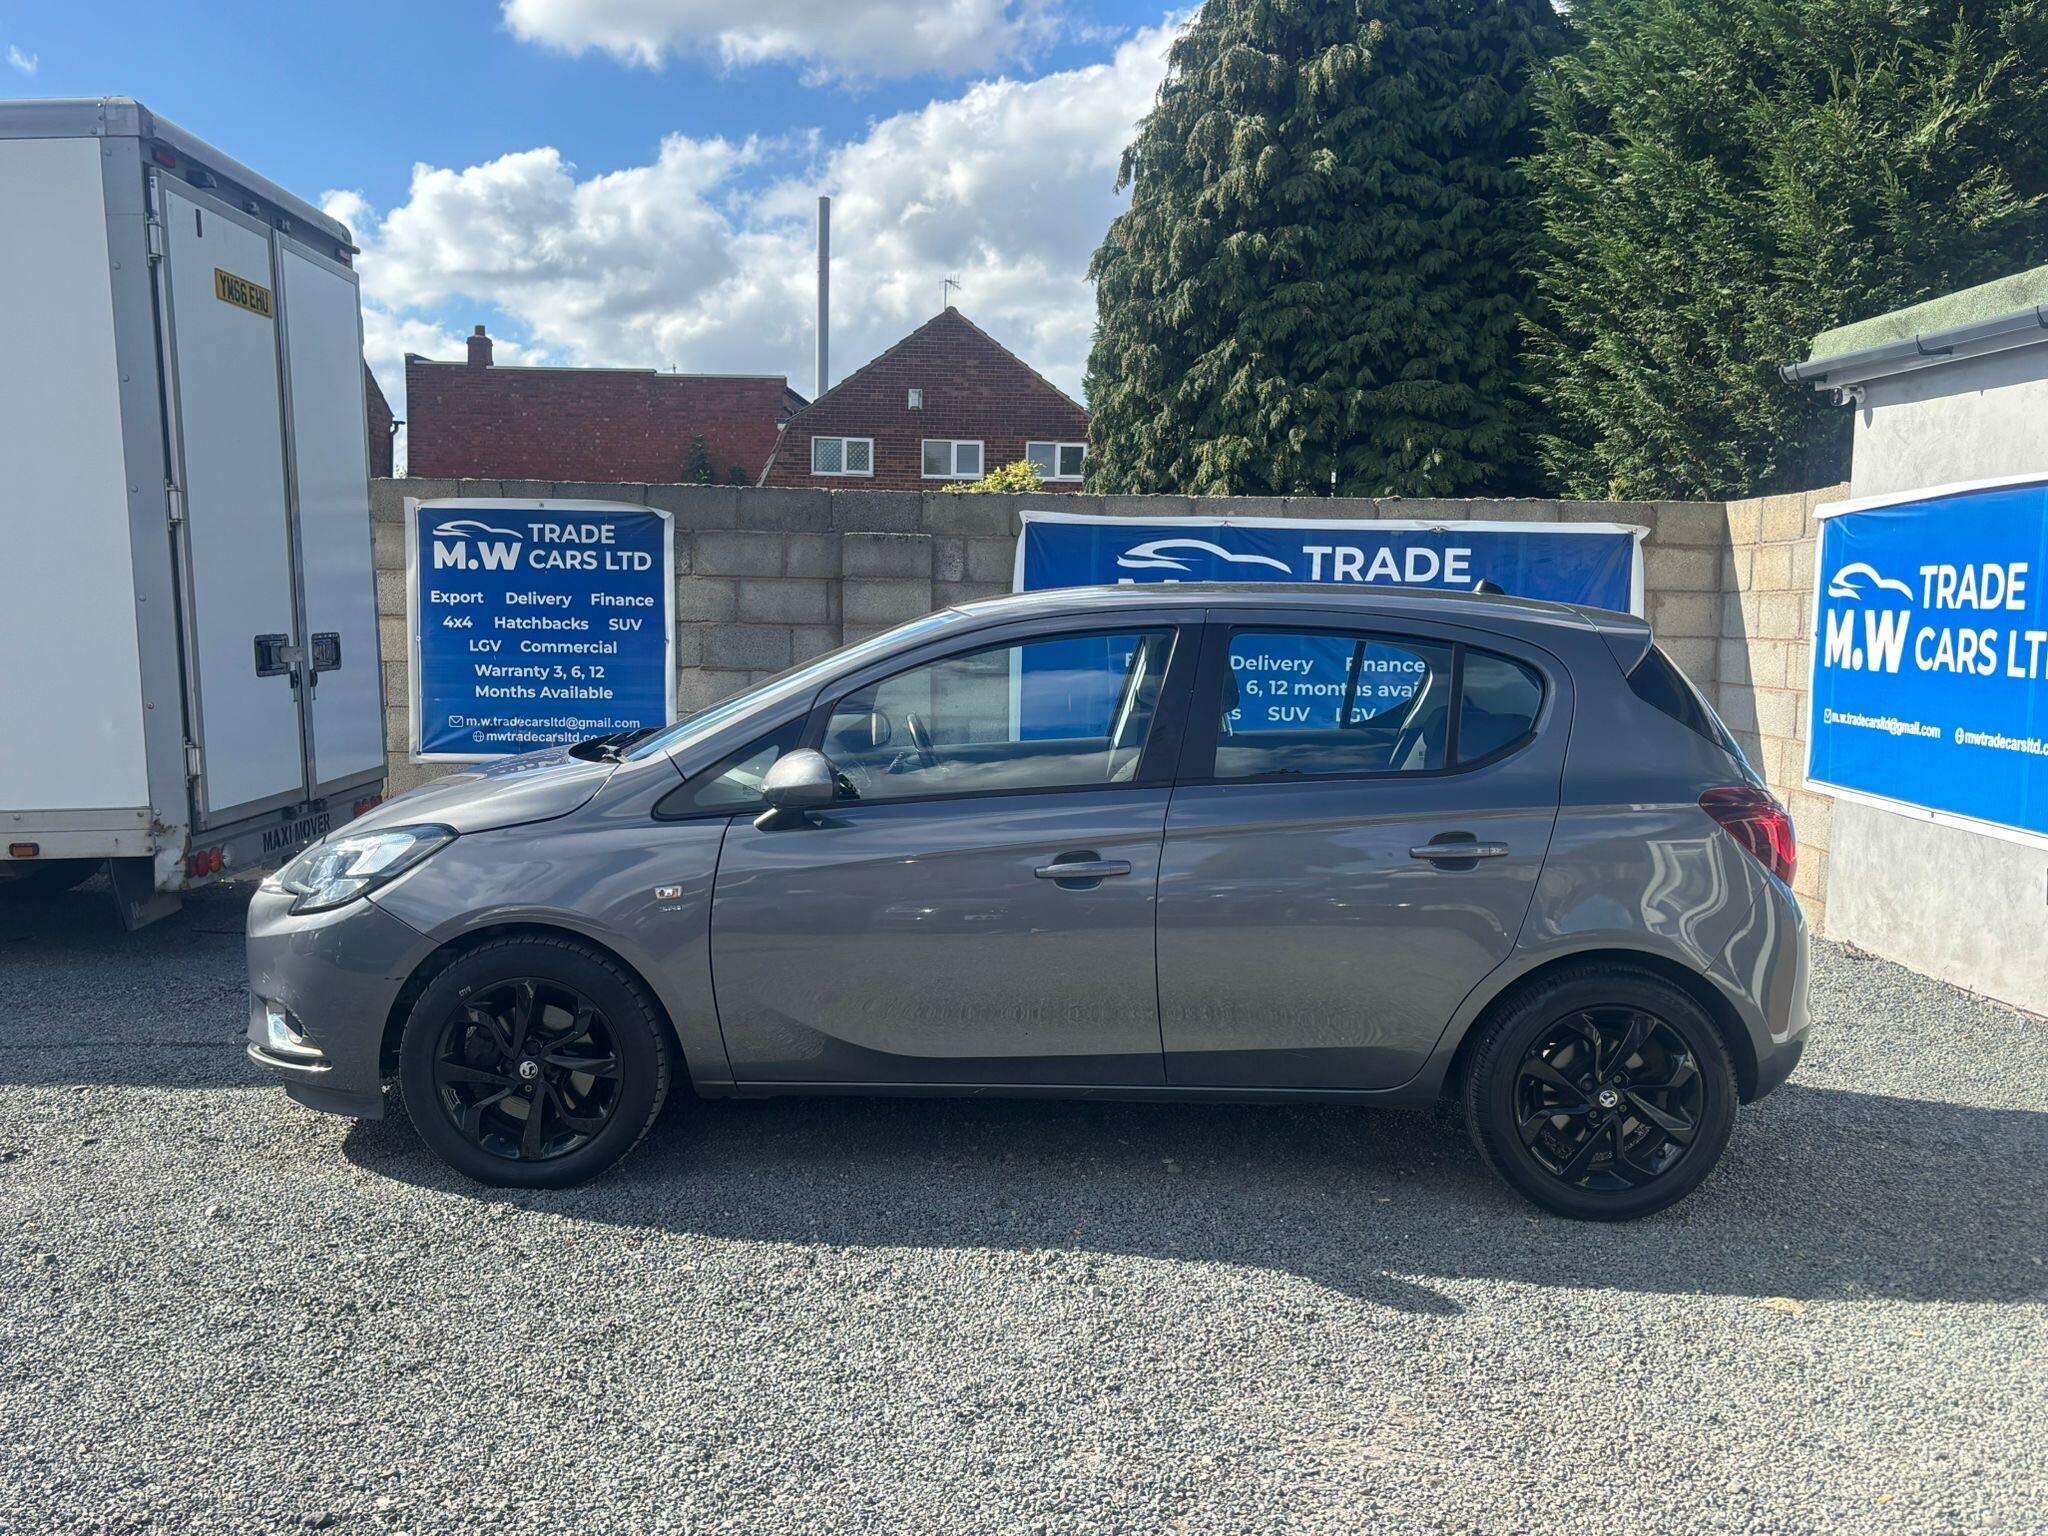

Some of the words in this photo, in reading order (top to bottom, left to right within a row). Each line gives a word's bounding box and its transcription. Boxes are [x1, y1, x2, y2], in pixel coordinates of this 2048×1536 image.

[527, 523, 616, 544] TRADE
[433, 540, 522, 571] M.W
[529, 549, 598, 570] CARS
[605, 551, 652, 571] LTD
[1302, 545, 1472, 584] TRADE
[1919, 562, 2028, 611] TRADE
[430, 590, 484, 607] Export
[505, 591, 572, 608] Delivery
[591, 592, 655, 607] Finance
[442, 615, 473, 629] 4x4
[494, 616, 589, 631] Hatchbacks
[608, 618, 643, 631] SUV
[469, 639, 502, 653] LGV
[520, 640, 618, 655] Commercial
[1824, 608, 1911, 674] M.W
[1914, 626, 1998, 676] CARS
[2006, 629, 2048, 680] LT
[475, 664, 549, 680] Warranty
[553, 665, 567, 680] 3,
[571, 665, 585, 680] 6,
[589, 665, 605, 679] 12
[1230, 654, 1314, 676] Delivery
[1345, 656, 1426, 674] Fnance
[475, 685, 536, 699] Months
[539, 685, 614, 700] Available
[1246, 680, 1263, 697] 6,
[1268, 680, 1288, 696] 12
[466, 715, 641, 730] m.w.tradecarsltd@gmail.com
[1267, 706, 1311, 722] SUV
[262, 824, 292, 853] MAXI
